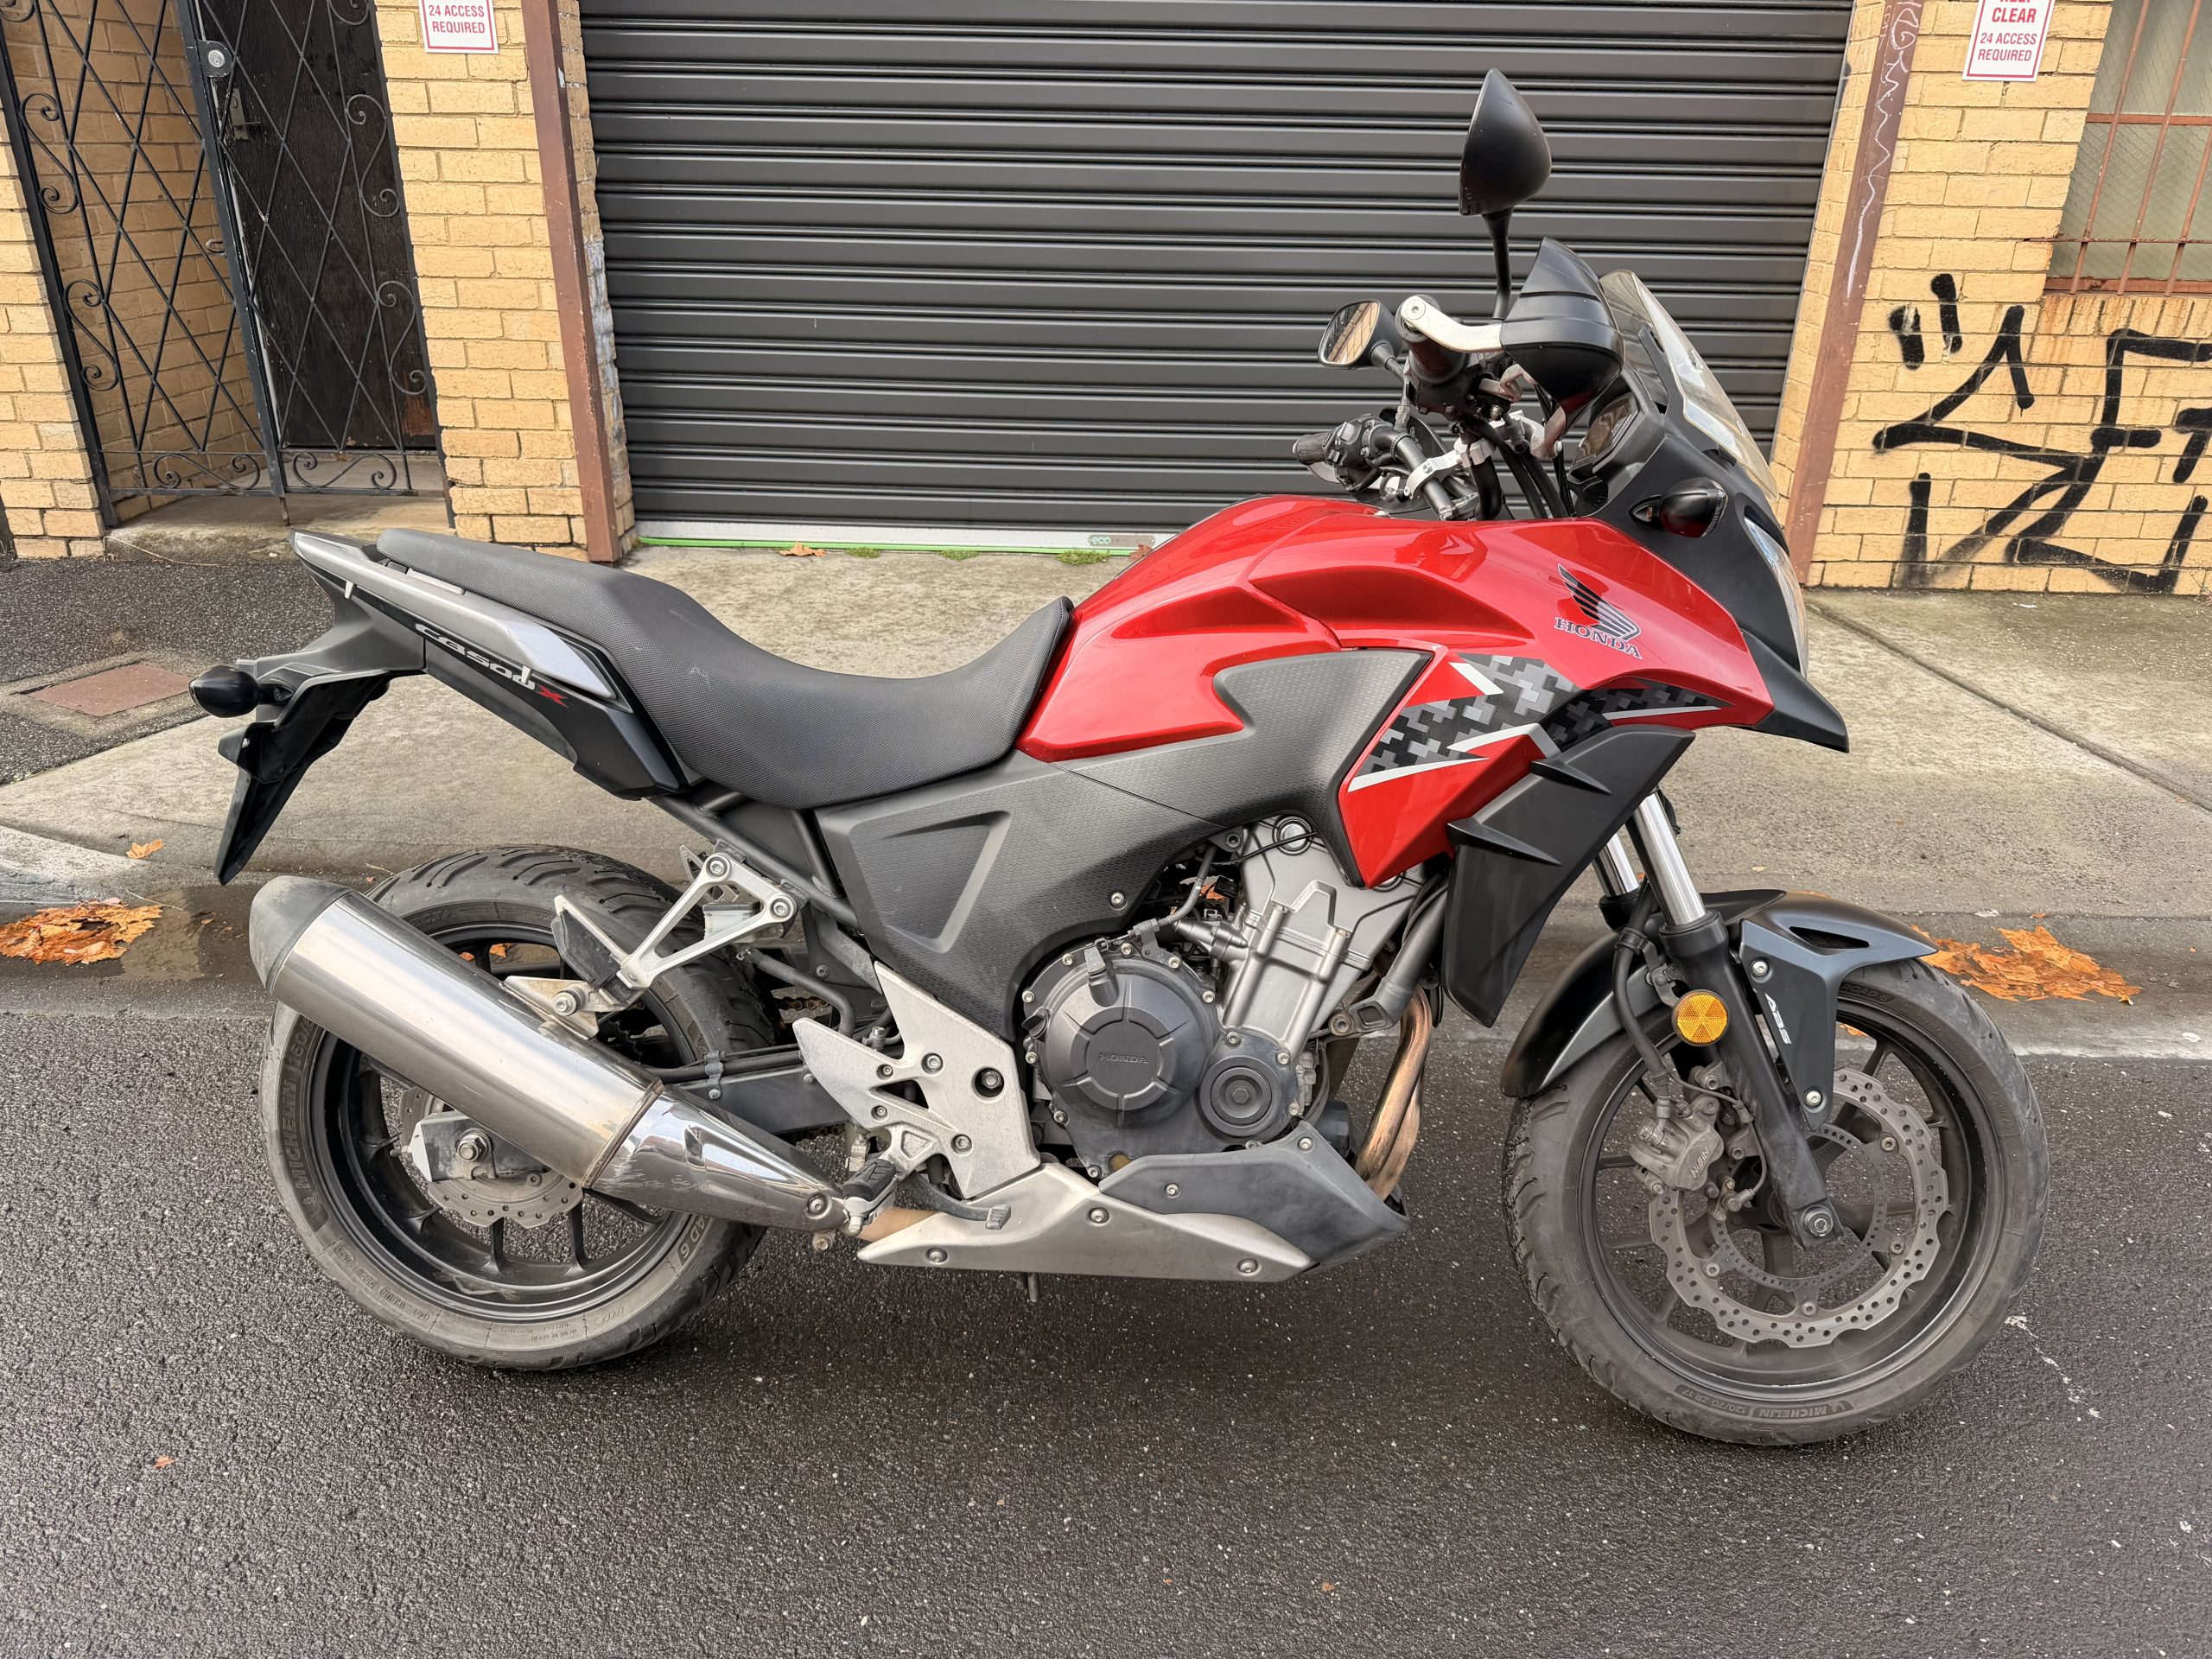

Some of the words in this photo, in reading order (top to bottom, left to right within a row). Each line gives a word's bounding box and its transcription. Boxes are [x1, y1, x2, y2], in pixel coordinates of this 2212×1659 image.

[429, 5, 442, 16] 24
[444, 5, 485, 17] ACCESS
[1992, 7, 2037, 23] CLEAR
[432, 21, 485, 34] REQUIRED
[1980, 32, 1993, 44] 24
[1995, 33, 2037, 45] ACCESS
[1977, 48, 2032, 61] REQUIRED
[1091, 536, 1112, 545] eco
[1554, 616, 1643, 660] HONDA
[1764, 992, 1792, 1045] ABS
[1098, 1052, 1149, 1065] HONDA
[283, 1079, 311, 1189] MICHELIN
[680, 1243, 690, 1259] 6
[1711, 1400, 1746, 1414] 120/70
[1758, 1405, 1827, 1418] MICHELIN
